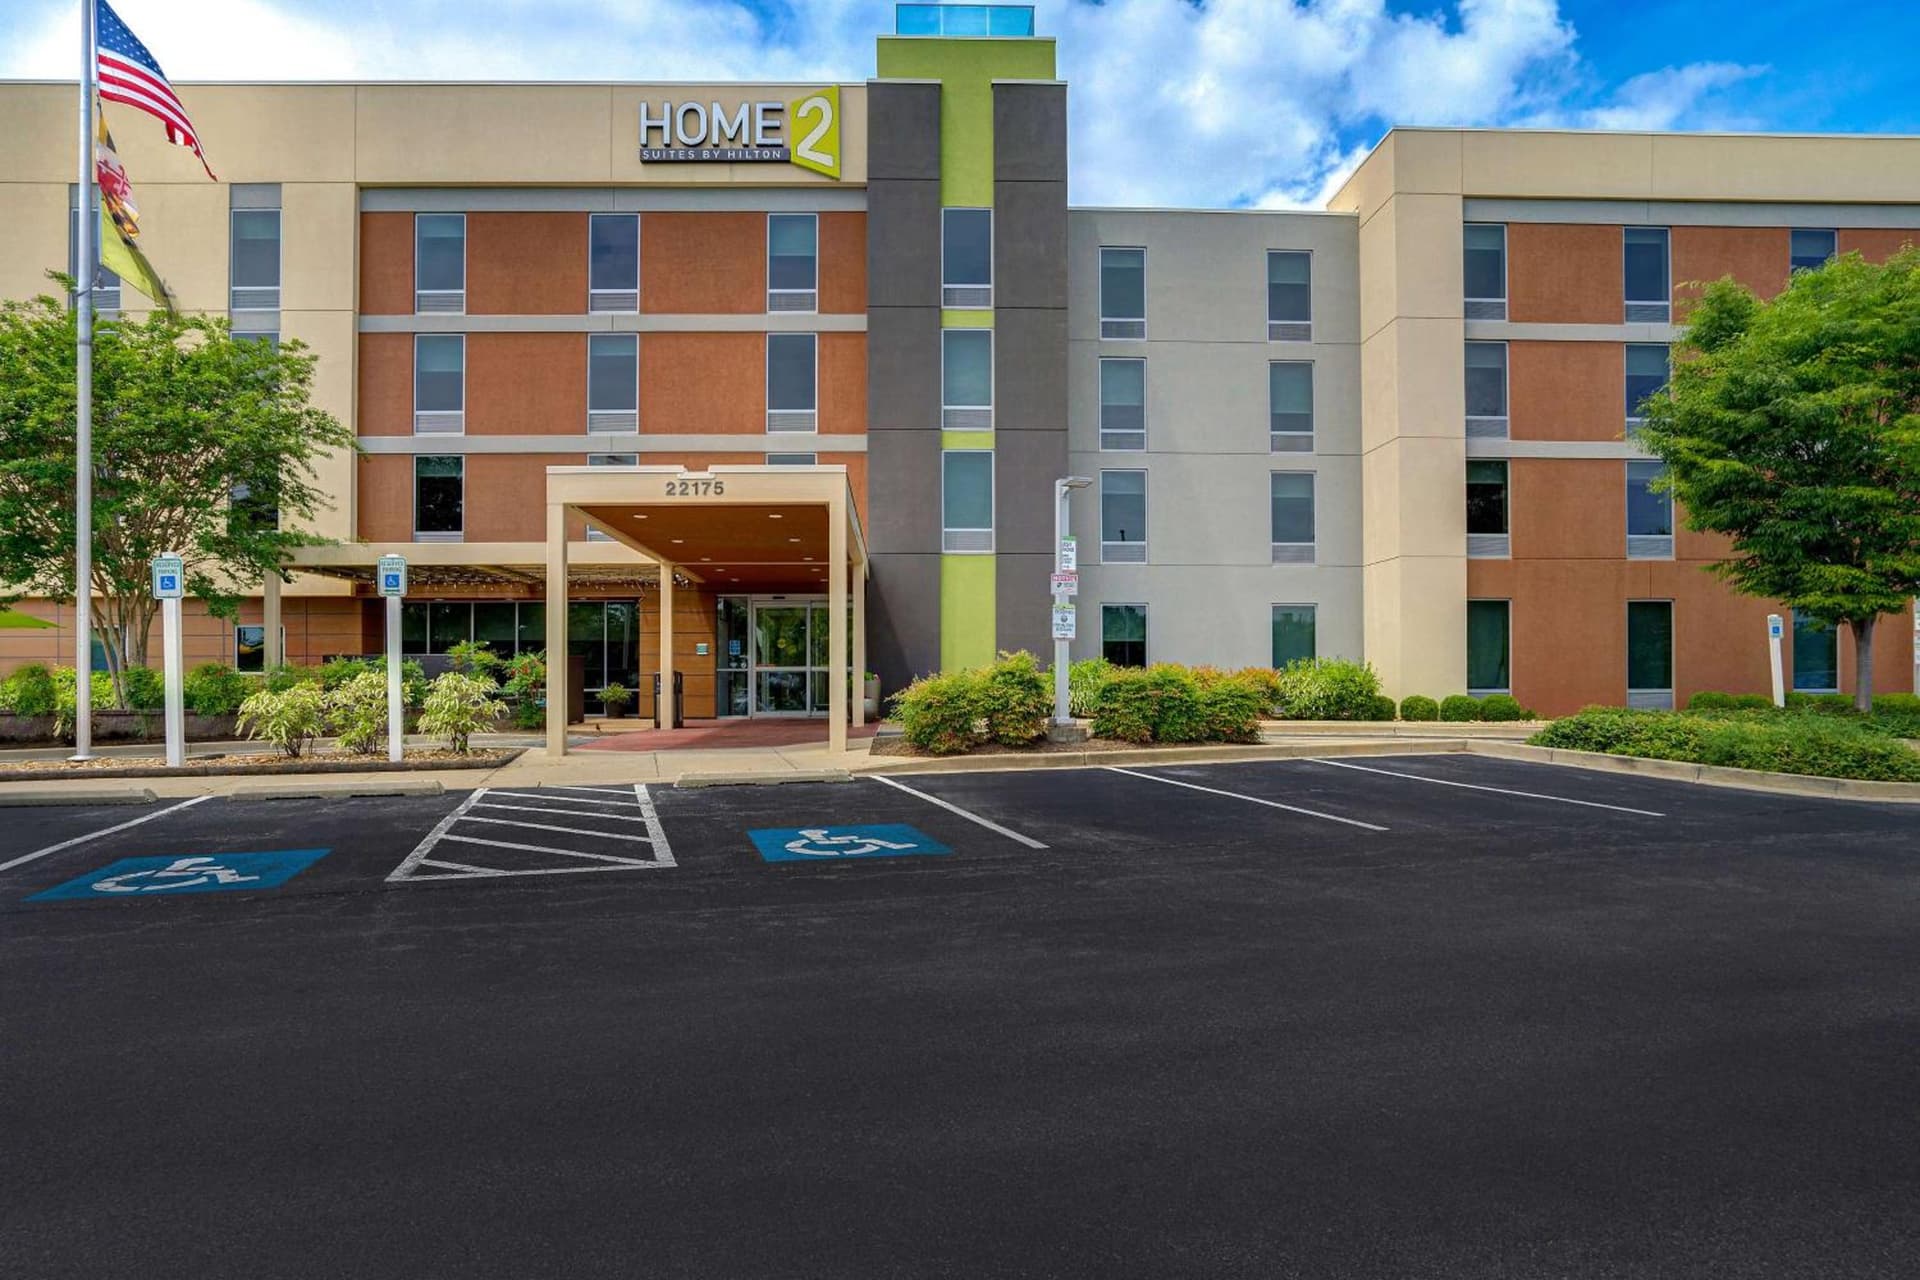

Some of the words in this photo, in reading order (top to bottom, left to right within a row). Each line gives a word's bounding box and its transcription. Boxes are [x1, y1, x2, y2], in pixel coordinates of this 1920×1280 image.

[640, 102, 784, 147] HOME
[796, 96, 834, 167] 2
[642, 150, 695, 160] SUITES
[702, 150, 720, 160] BY
[727, 150, 781, 160] HILTON
[665, 481, 725, 496] 22175
